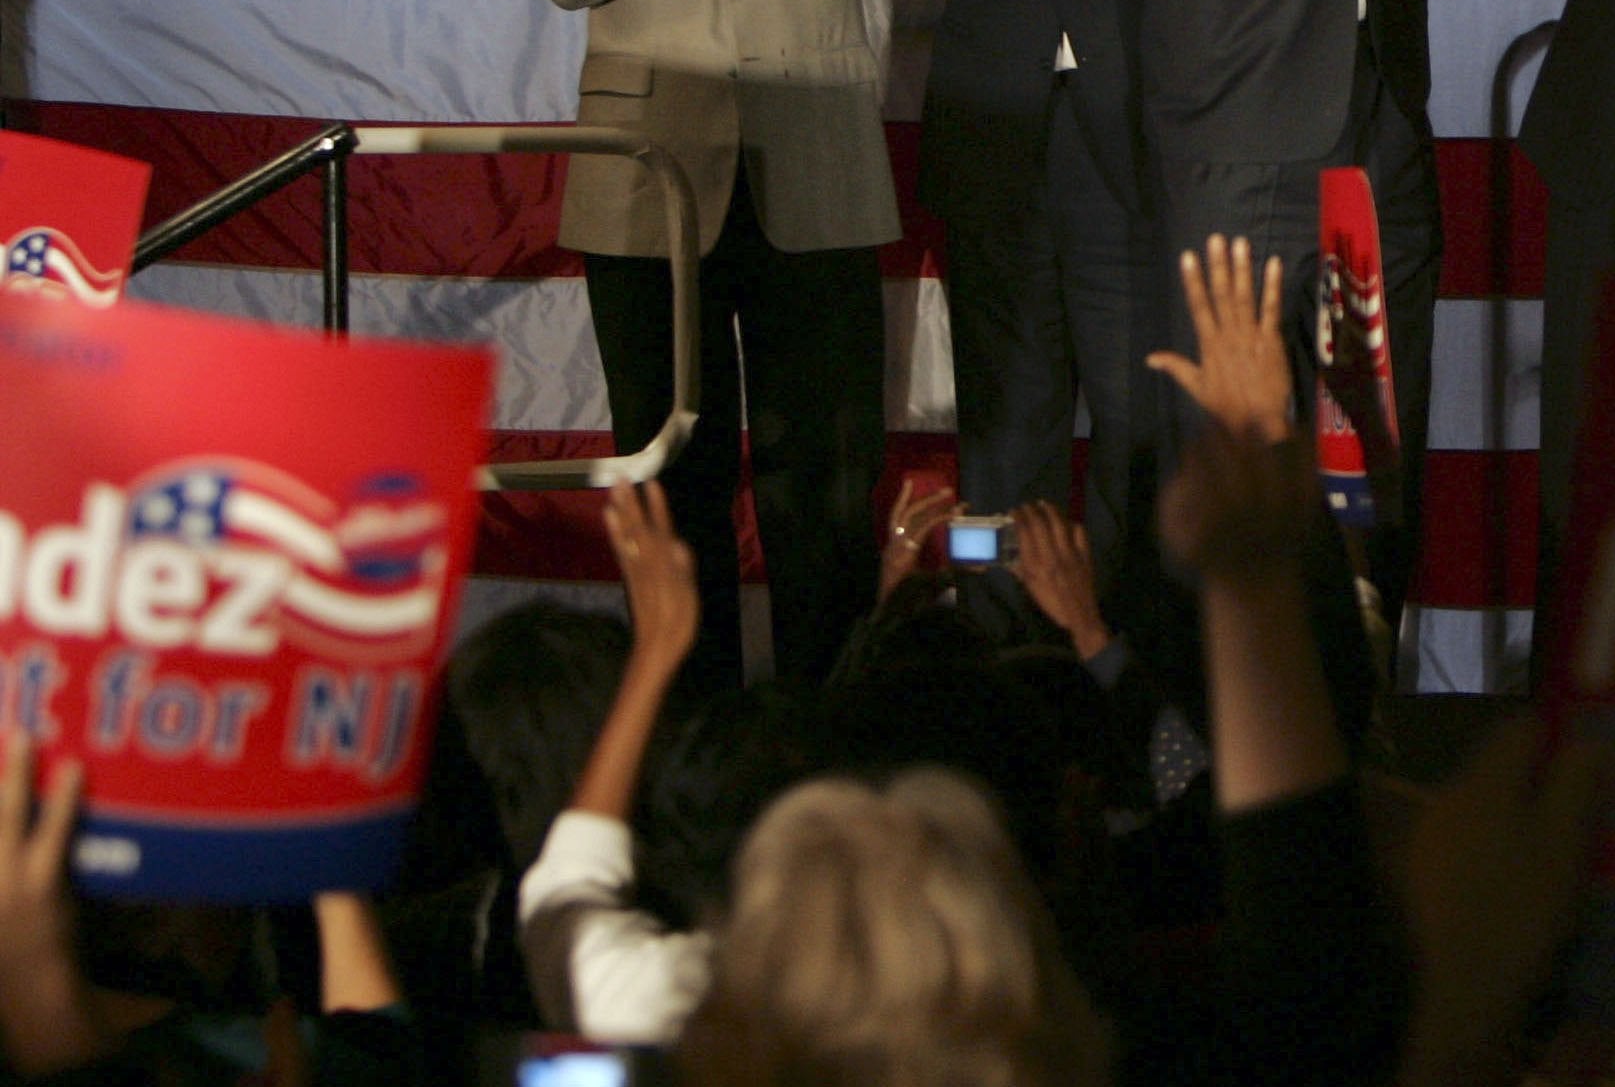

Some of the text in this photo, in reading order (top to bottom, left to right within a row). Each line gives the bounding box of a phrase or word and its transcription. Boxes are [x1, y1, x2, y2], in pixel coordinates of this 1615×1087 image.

[0, 482, 280, 657] dez
[84, 647, 272, 765] for
[283, 664, 423, 784] NJ
